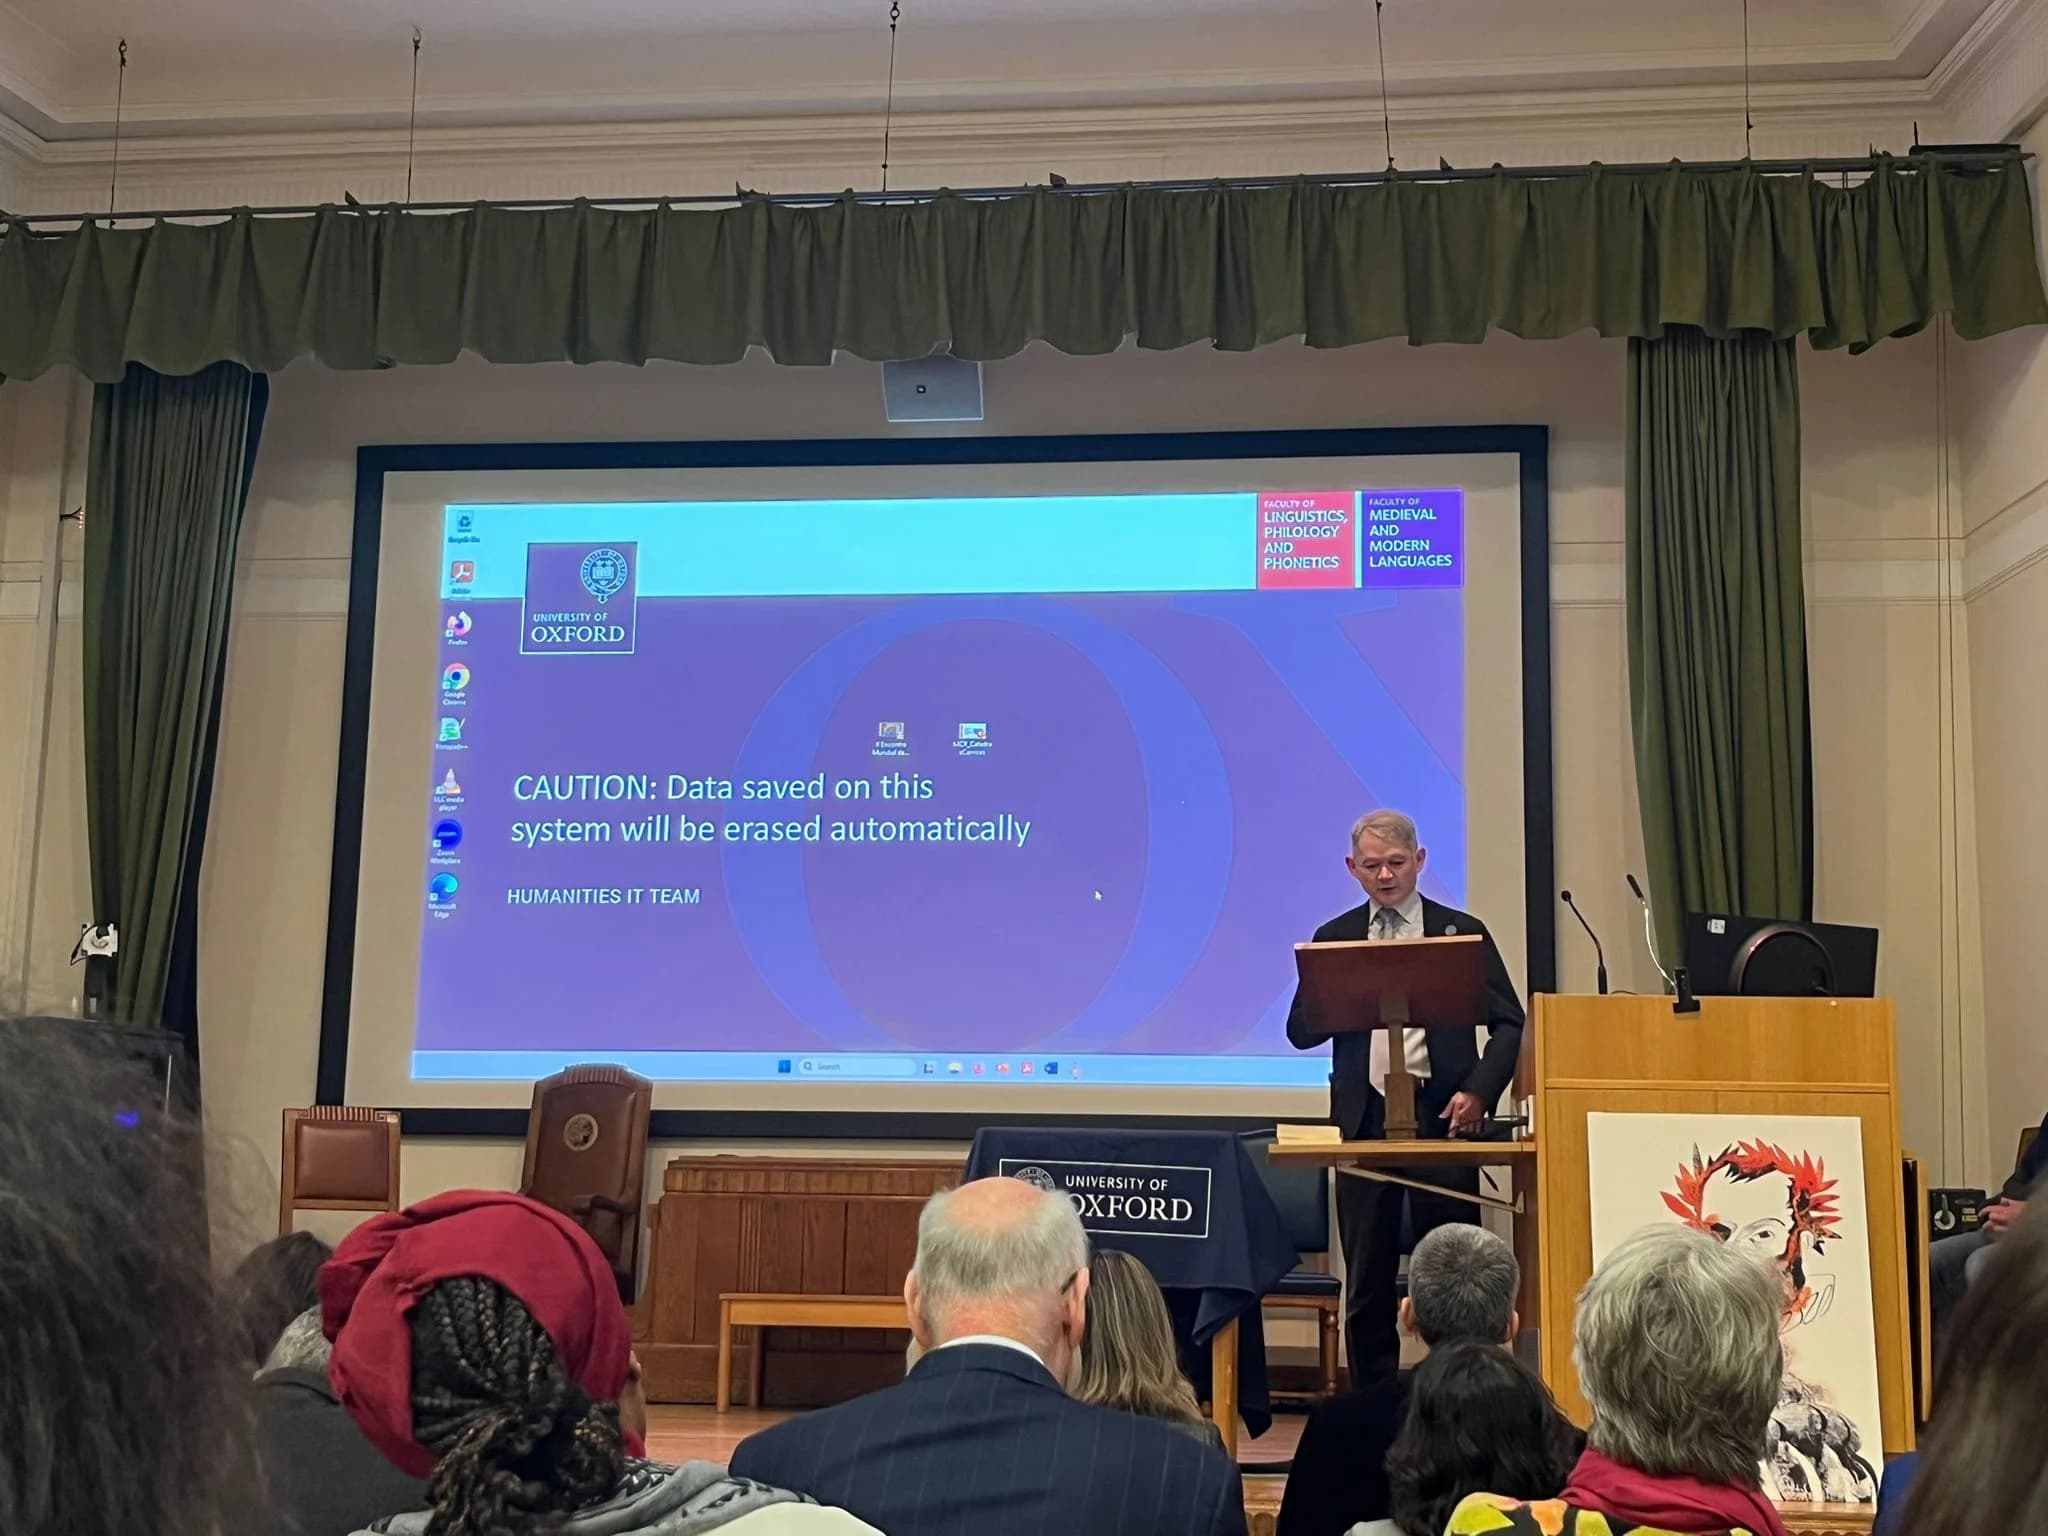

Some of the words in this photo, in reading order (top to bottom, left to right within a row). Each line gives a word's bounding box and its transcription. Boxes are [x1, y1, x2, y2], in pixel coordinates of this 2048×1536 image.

[1264, 500, 1300, 508] FACULTY
[1302, 499, 1315, 508] OF
[1369, 498, 1406, 506] FACULTY
[1408, 498, 1420, 506] OF
[1264, 510, 1348, 524] LINGUISTICS,
[1369, 508, 1437, 521] MEDIEVAL
[1264, 526, 1340, 539] PHILOLOGY
[1369, 525, 1400, 537] AND
[1264, 542, 1294, 554] AND
[1369, 539, 1430, 552] MODERN
[1264, 556, 1340, 570] PHONETICS
[1369, 554, 1452, 568] LANGUAGES
[533, 613, 591, 622] UNIVERSITY
[594, 613, 608, 622] OF
[531, 626, 625, 643] OXFORD
[514, 774, 657, 800] CAUTION:
[668, 774, 733, 800] Data
[742, 772, 825, 800] saved
[835, 779, 870, 799] on
[880, 772, 933, 799] this
[511, 818, 611, 848] system
[620, 814, 670, 841] will
[680, 814, 714, 841] be
[724, 814, 821, 841] erased
[830, 814, 1031, 848] automatically
[507, 888, 622, 904] HUMANITIES
[627, 888, 644, 904] IT
[650, 888, 700, 904] TEAM
[1065, 1175, 1145, 1190] UNIVERSITY
[1150, 1178, 1169, 1191] OF
